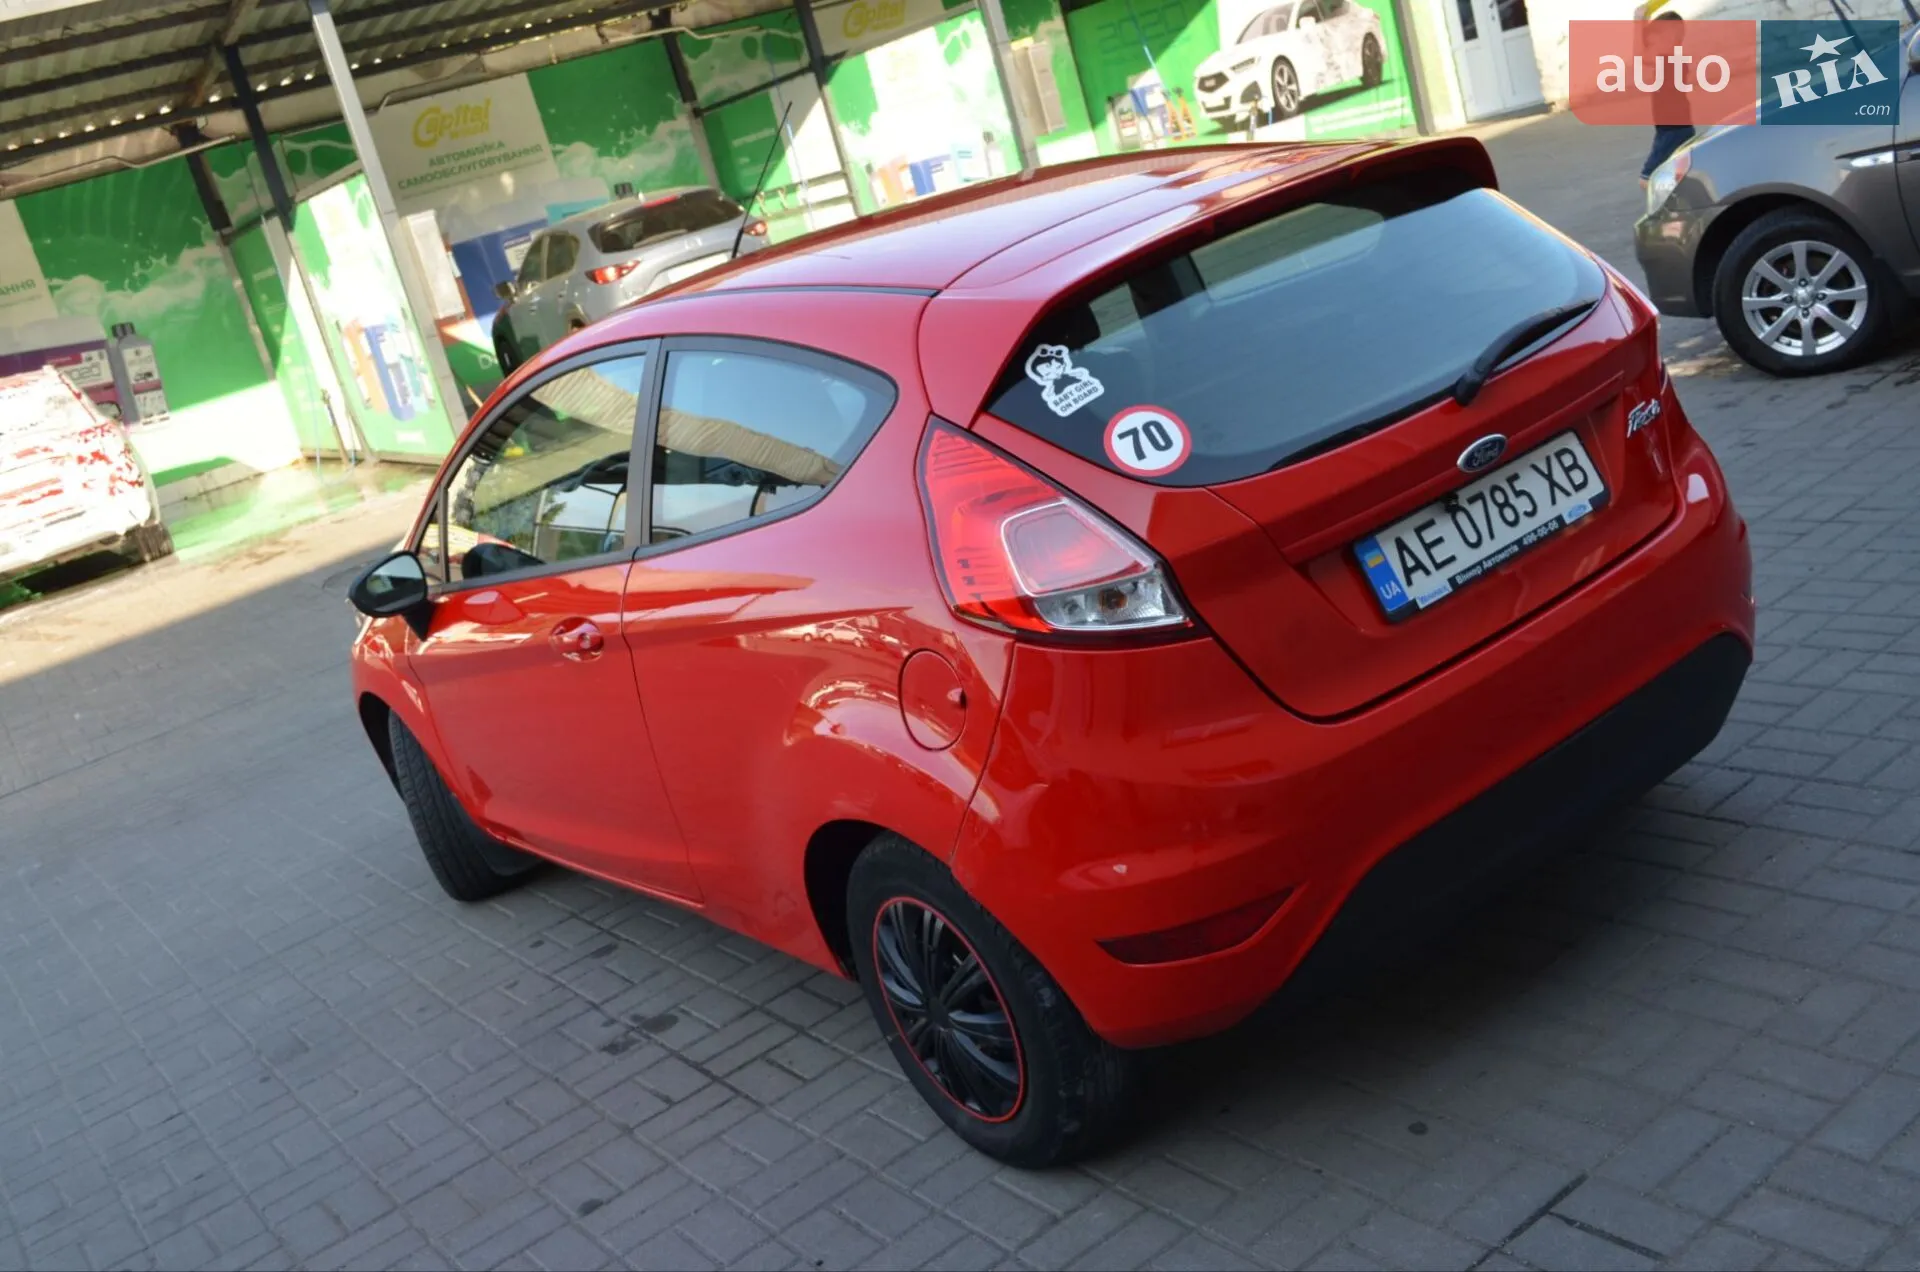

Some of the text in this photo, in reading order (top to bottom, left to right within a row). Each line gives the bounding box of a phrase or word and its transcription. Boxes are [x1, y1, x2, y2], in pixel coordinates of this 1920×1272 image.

[1053, 379, 1095, 408] BABY GIRL
[1060, 386, 1099, 413] ON BOARD
[1117, 419, 1174, 461] 70
[1394, 447, 1589, 588] AE 0785 XB
[1379, 580, 1402, 600] UA
